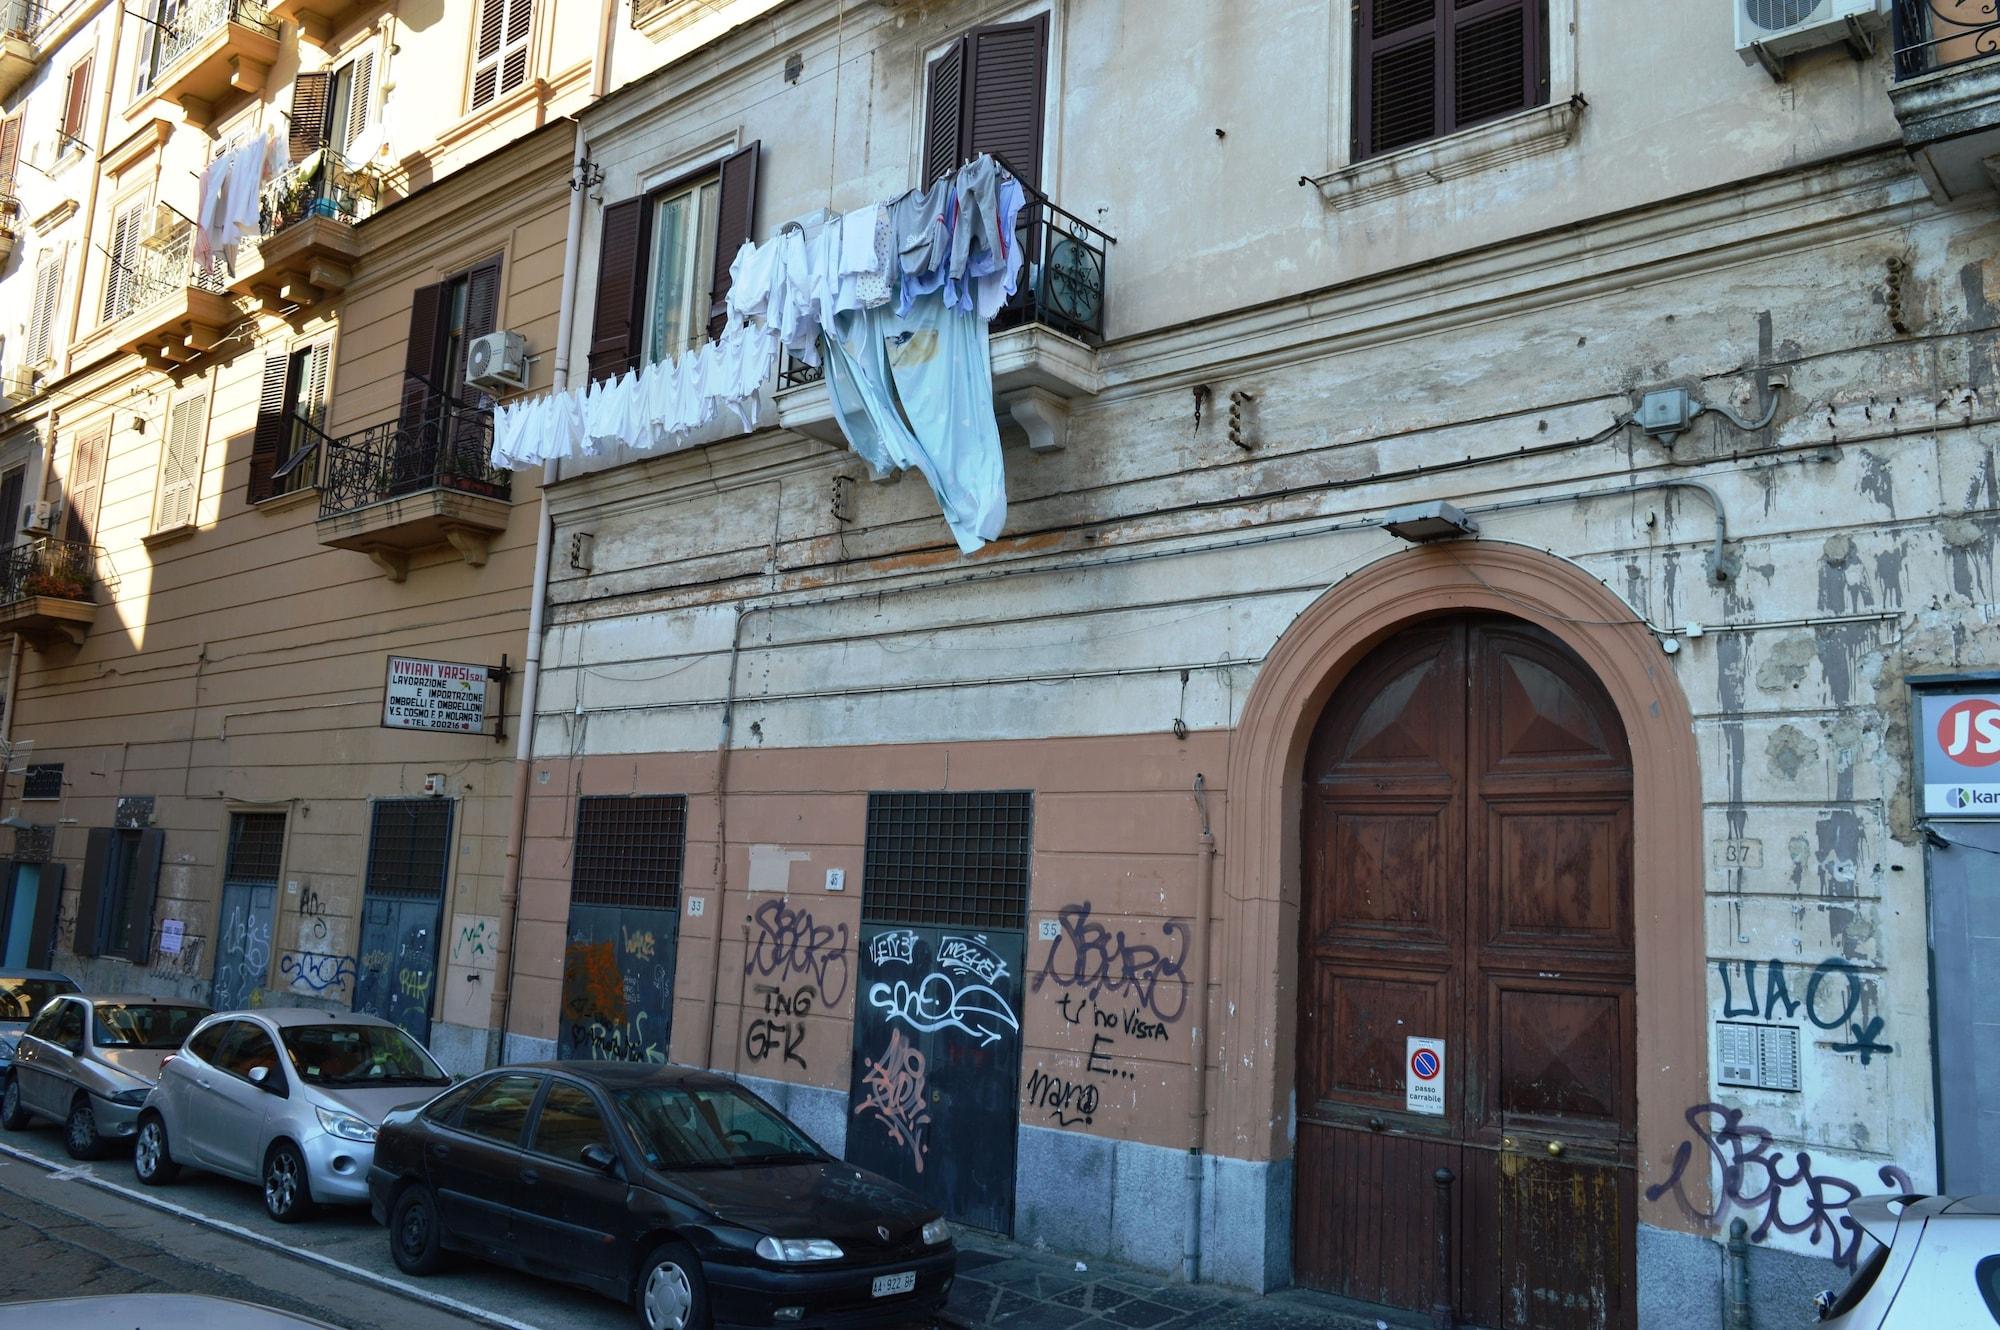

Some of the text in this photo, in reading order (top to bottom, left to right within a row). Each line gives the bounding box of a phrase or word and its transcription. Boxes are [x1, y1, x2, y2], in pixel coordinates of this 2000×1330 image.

[394, 660, 433, 678] VIVIANI
[438, 665, 470, 681] VARSI
[392, 675, 447, 689] LAVORAZIONE
[417, 688, 483, 703] E IMPORTAZIONE
[390, 696, 482, 713] OMBRELLI E OMBRELLONI
[404, 708, 429, 719] COSMO
[431, 710, 435, 719] E
[431, 720, 460, 729] 200216
[1043, 922, 1057, 936] 35
[754, 984, 817, 1018] TNG
[746, 1018, 808, 1071] GFK
[1415, 1085, 1436, 1094] passo
[1409, 1093, 1442, 1103] carrabile
